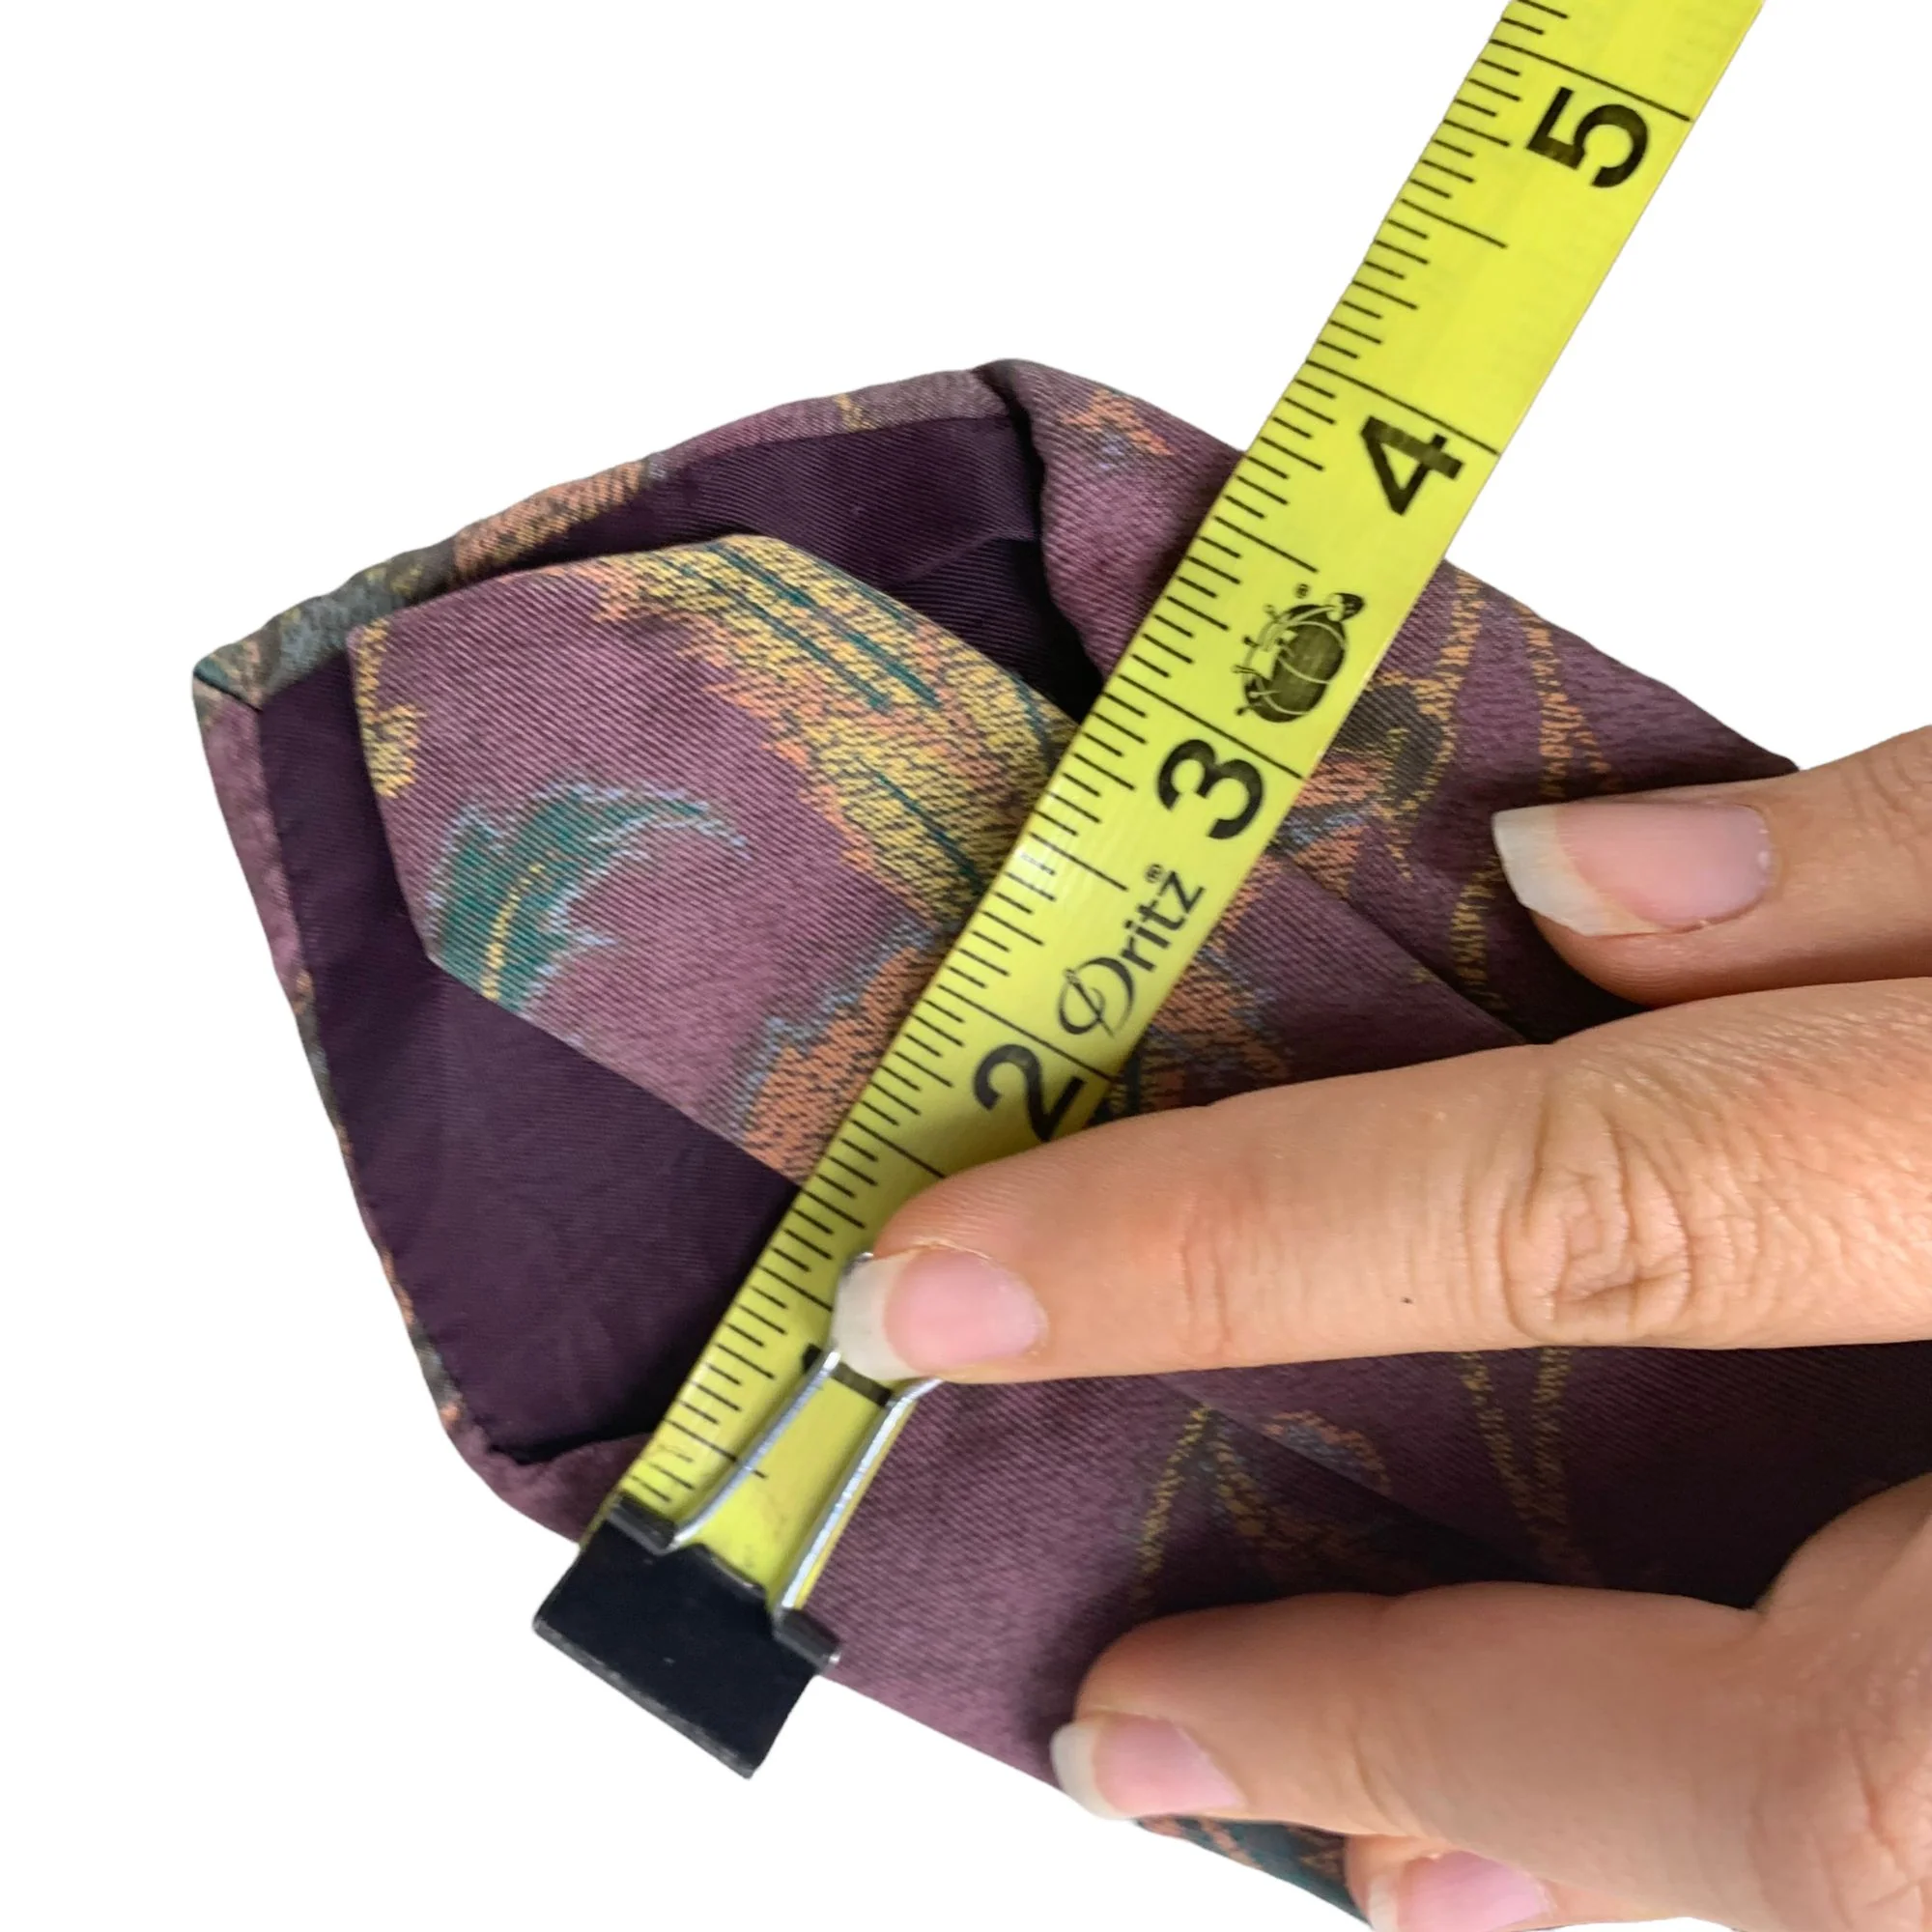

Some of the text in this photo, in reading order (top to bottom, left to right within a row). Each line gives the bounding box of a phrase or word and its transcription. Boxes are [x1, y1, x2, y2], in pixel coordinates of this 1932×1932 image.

[1526, 86, 1649, 188] 5
[1358, 415, 1464, 516] 4
[1153, 739, 1265, 840] 3
[974, 1044, 1086, 1142] 2
